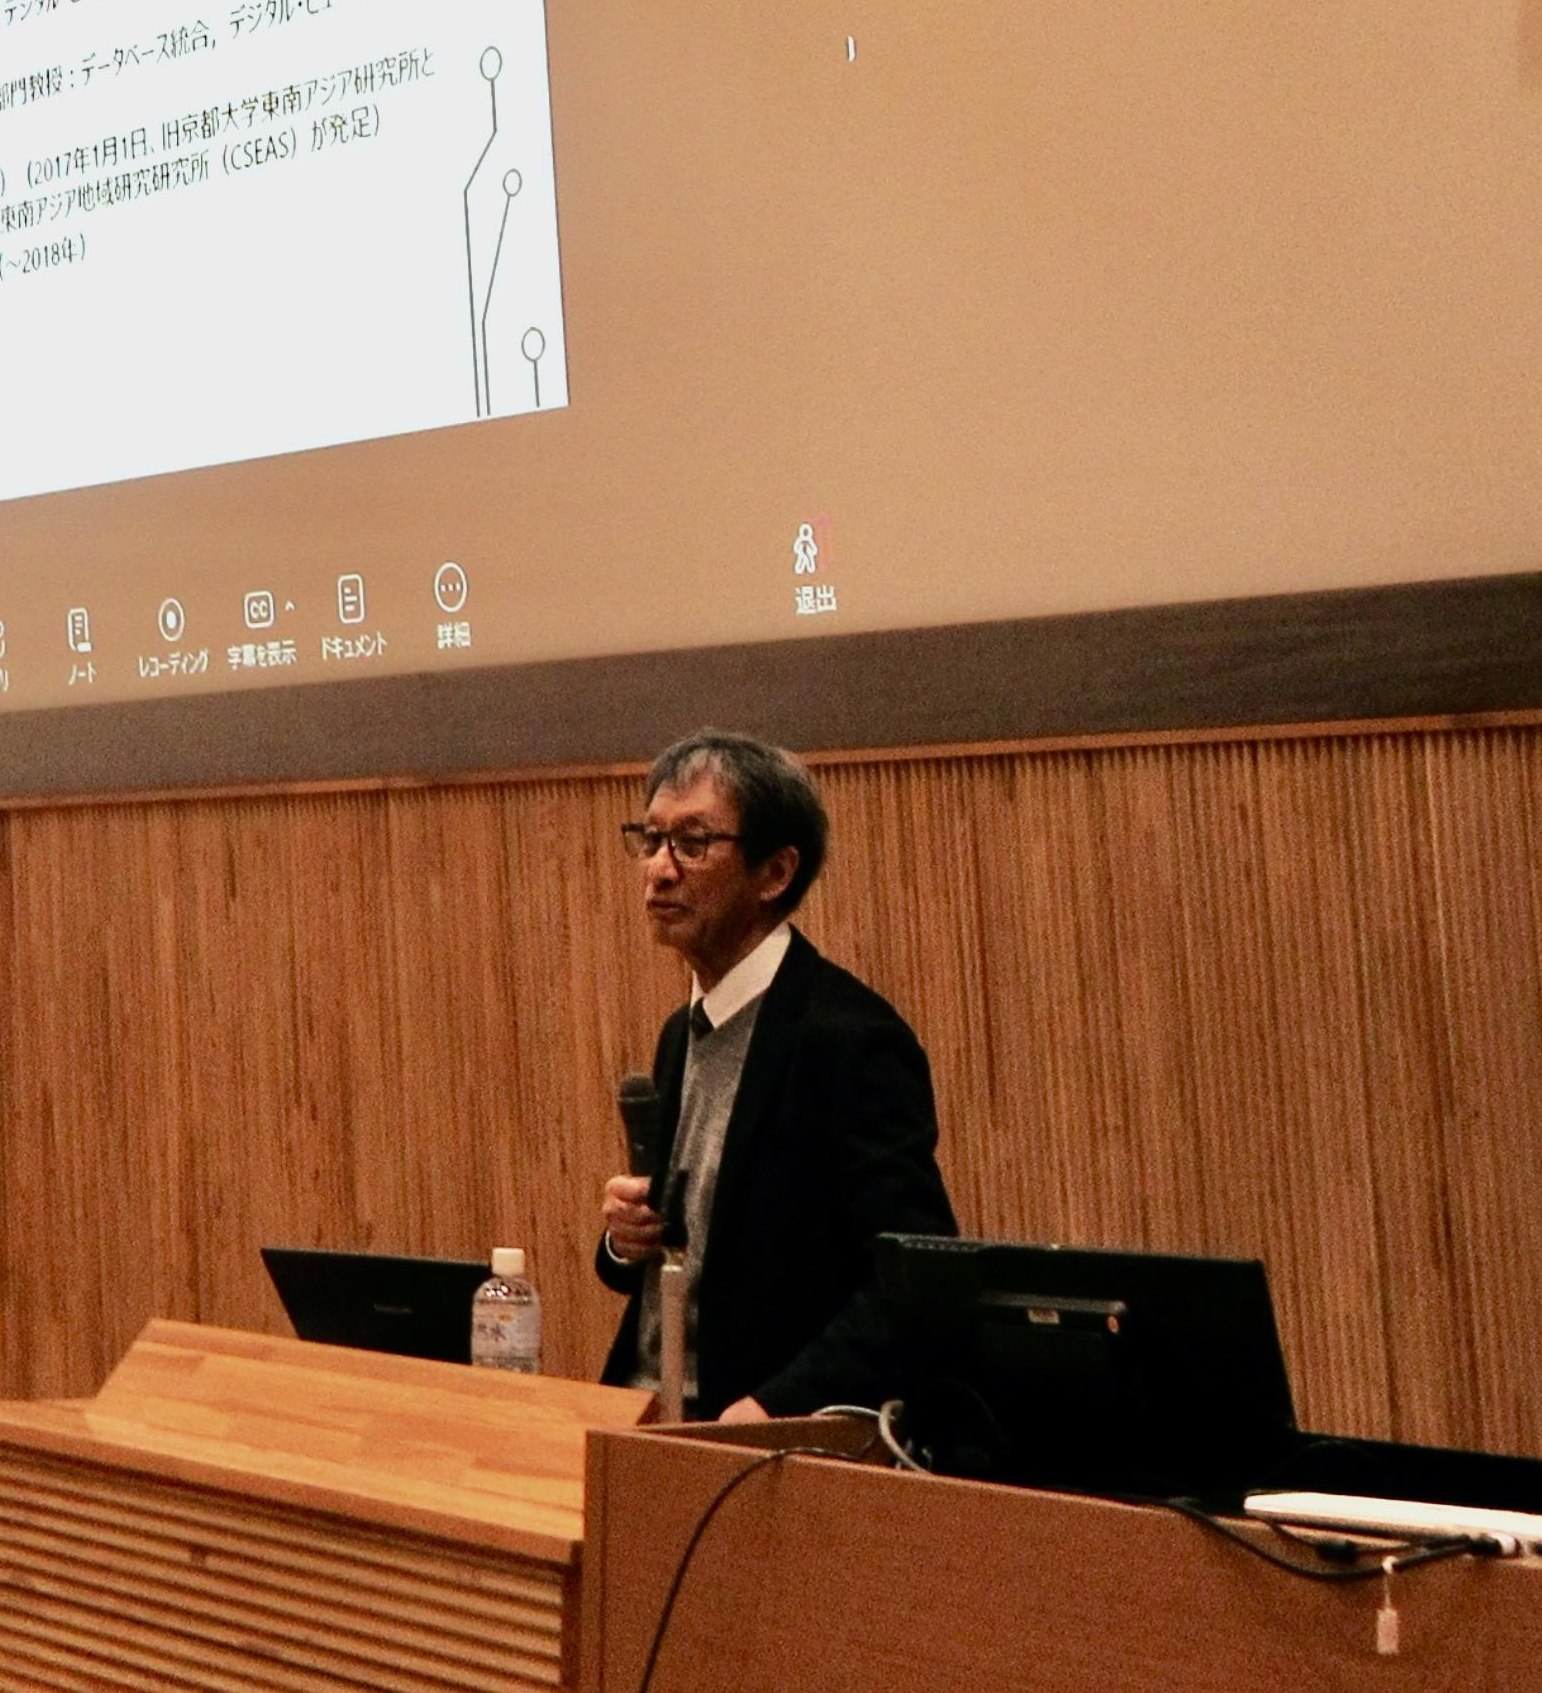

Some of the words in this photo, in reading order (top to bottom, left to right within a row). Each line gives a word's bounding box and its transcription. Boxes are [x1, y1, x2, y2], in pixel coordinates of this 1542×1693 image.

[795, 585, 837, 616] 退出
[321, 631, 388, 662] ドキュメント
[436, 620, 472, 650] 詳細
[139, 649, 209, 678] レコーディング
[226, 639, 298, 671] 字幕を表示
[68, 661, 97, 686] ノート
